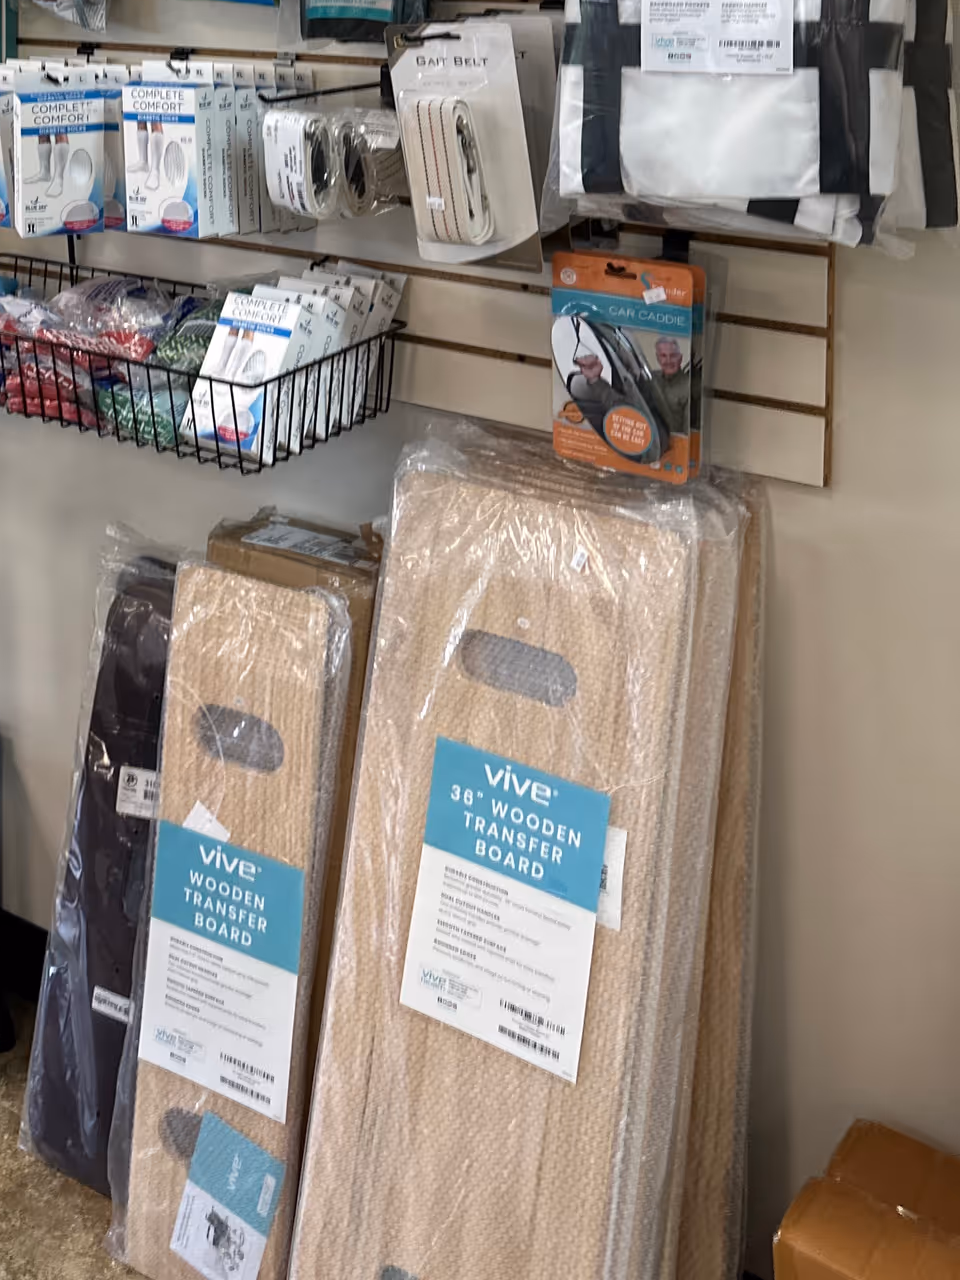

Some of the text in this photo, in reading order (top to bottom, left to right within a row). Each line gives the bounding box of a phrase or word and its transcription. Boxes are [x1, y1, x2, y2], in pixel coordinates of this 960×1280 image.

[416, 56, 488, 67] GAIT BELT
[131, 88, 184, 101] COMPLETE
[133, 101, 184, 113] COMFORT
[205, 119, 213, 173] COMPLETE
[232, 307, 285, 325] COMFORT
[234, 297, 288, 314] COMPLETE
[608, 306, 685, 326] CAR CADDIE
[484, 763, 551, 807] vive
[464, 811, 563, 865] TRANSFER
[492, 798, 581, 849] WOODEN
[200, 845, 257, 882] vive
[475, 839, 544, 880] BOARD
[190, 870, 265, 911] WOODEN
[184, 887, 267, 933] TRANSFER
[194, 912, 253, 947] BOARD
[227, 1154, 241, 1191] vive
